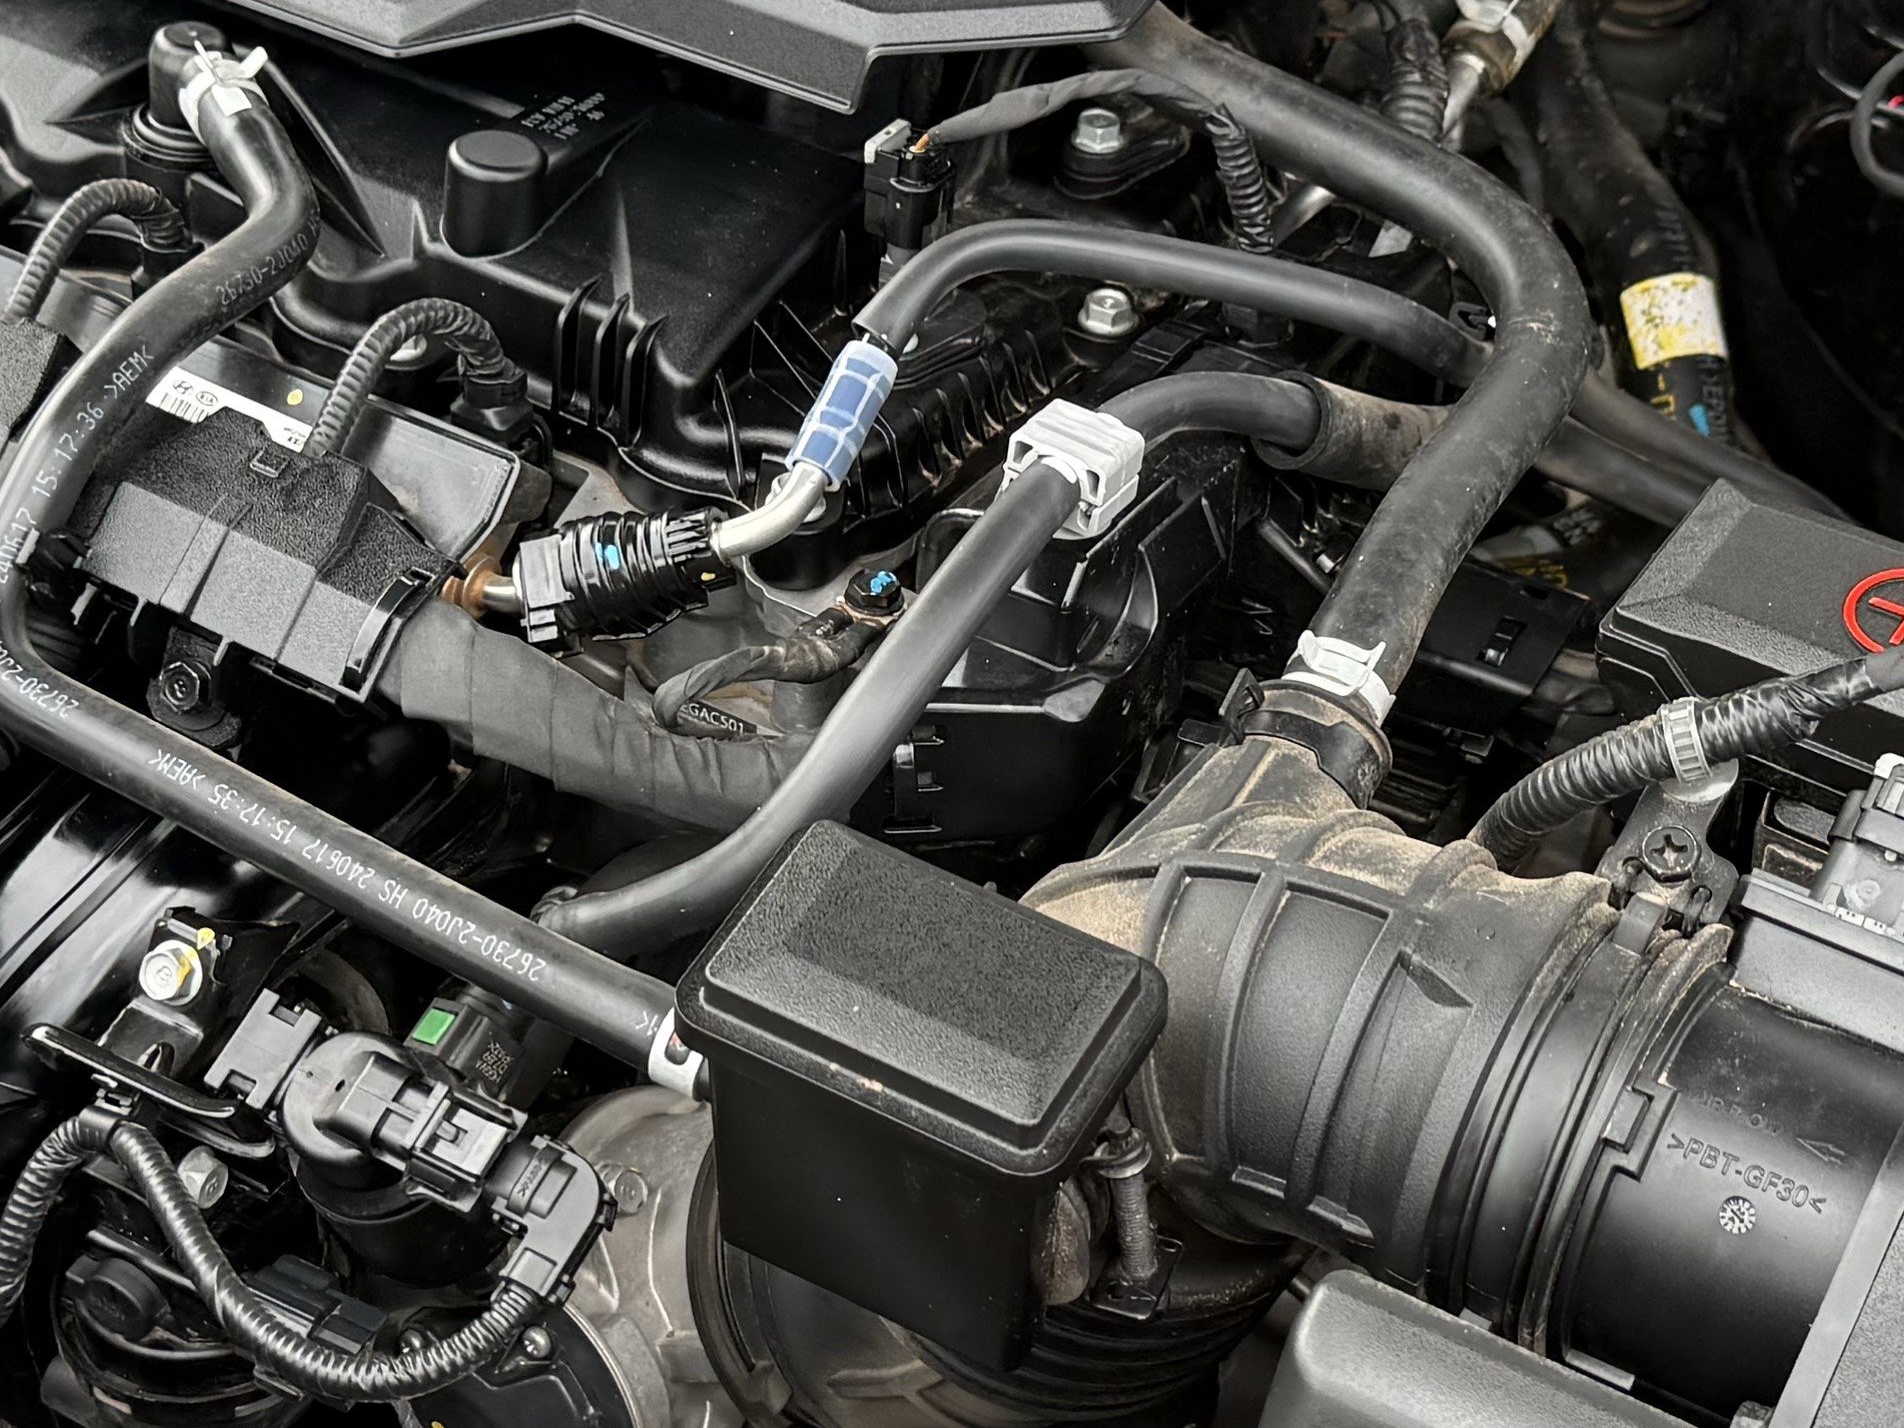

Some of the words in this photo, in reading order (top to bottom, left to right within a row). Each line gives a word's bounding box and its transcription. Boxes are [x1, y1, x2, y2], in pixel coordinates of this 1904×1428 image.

[32, 403, 105, 500] 15:17:36
[207, 781, 298, 840] 15:17:35
[301, 837, 377, 890] 240617
[376, 876, 410, 909] HS
[410, 897, 549, 983] 26730-2J040
[1666, 1132, 1827, 1215] >PBT-GF30<
